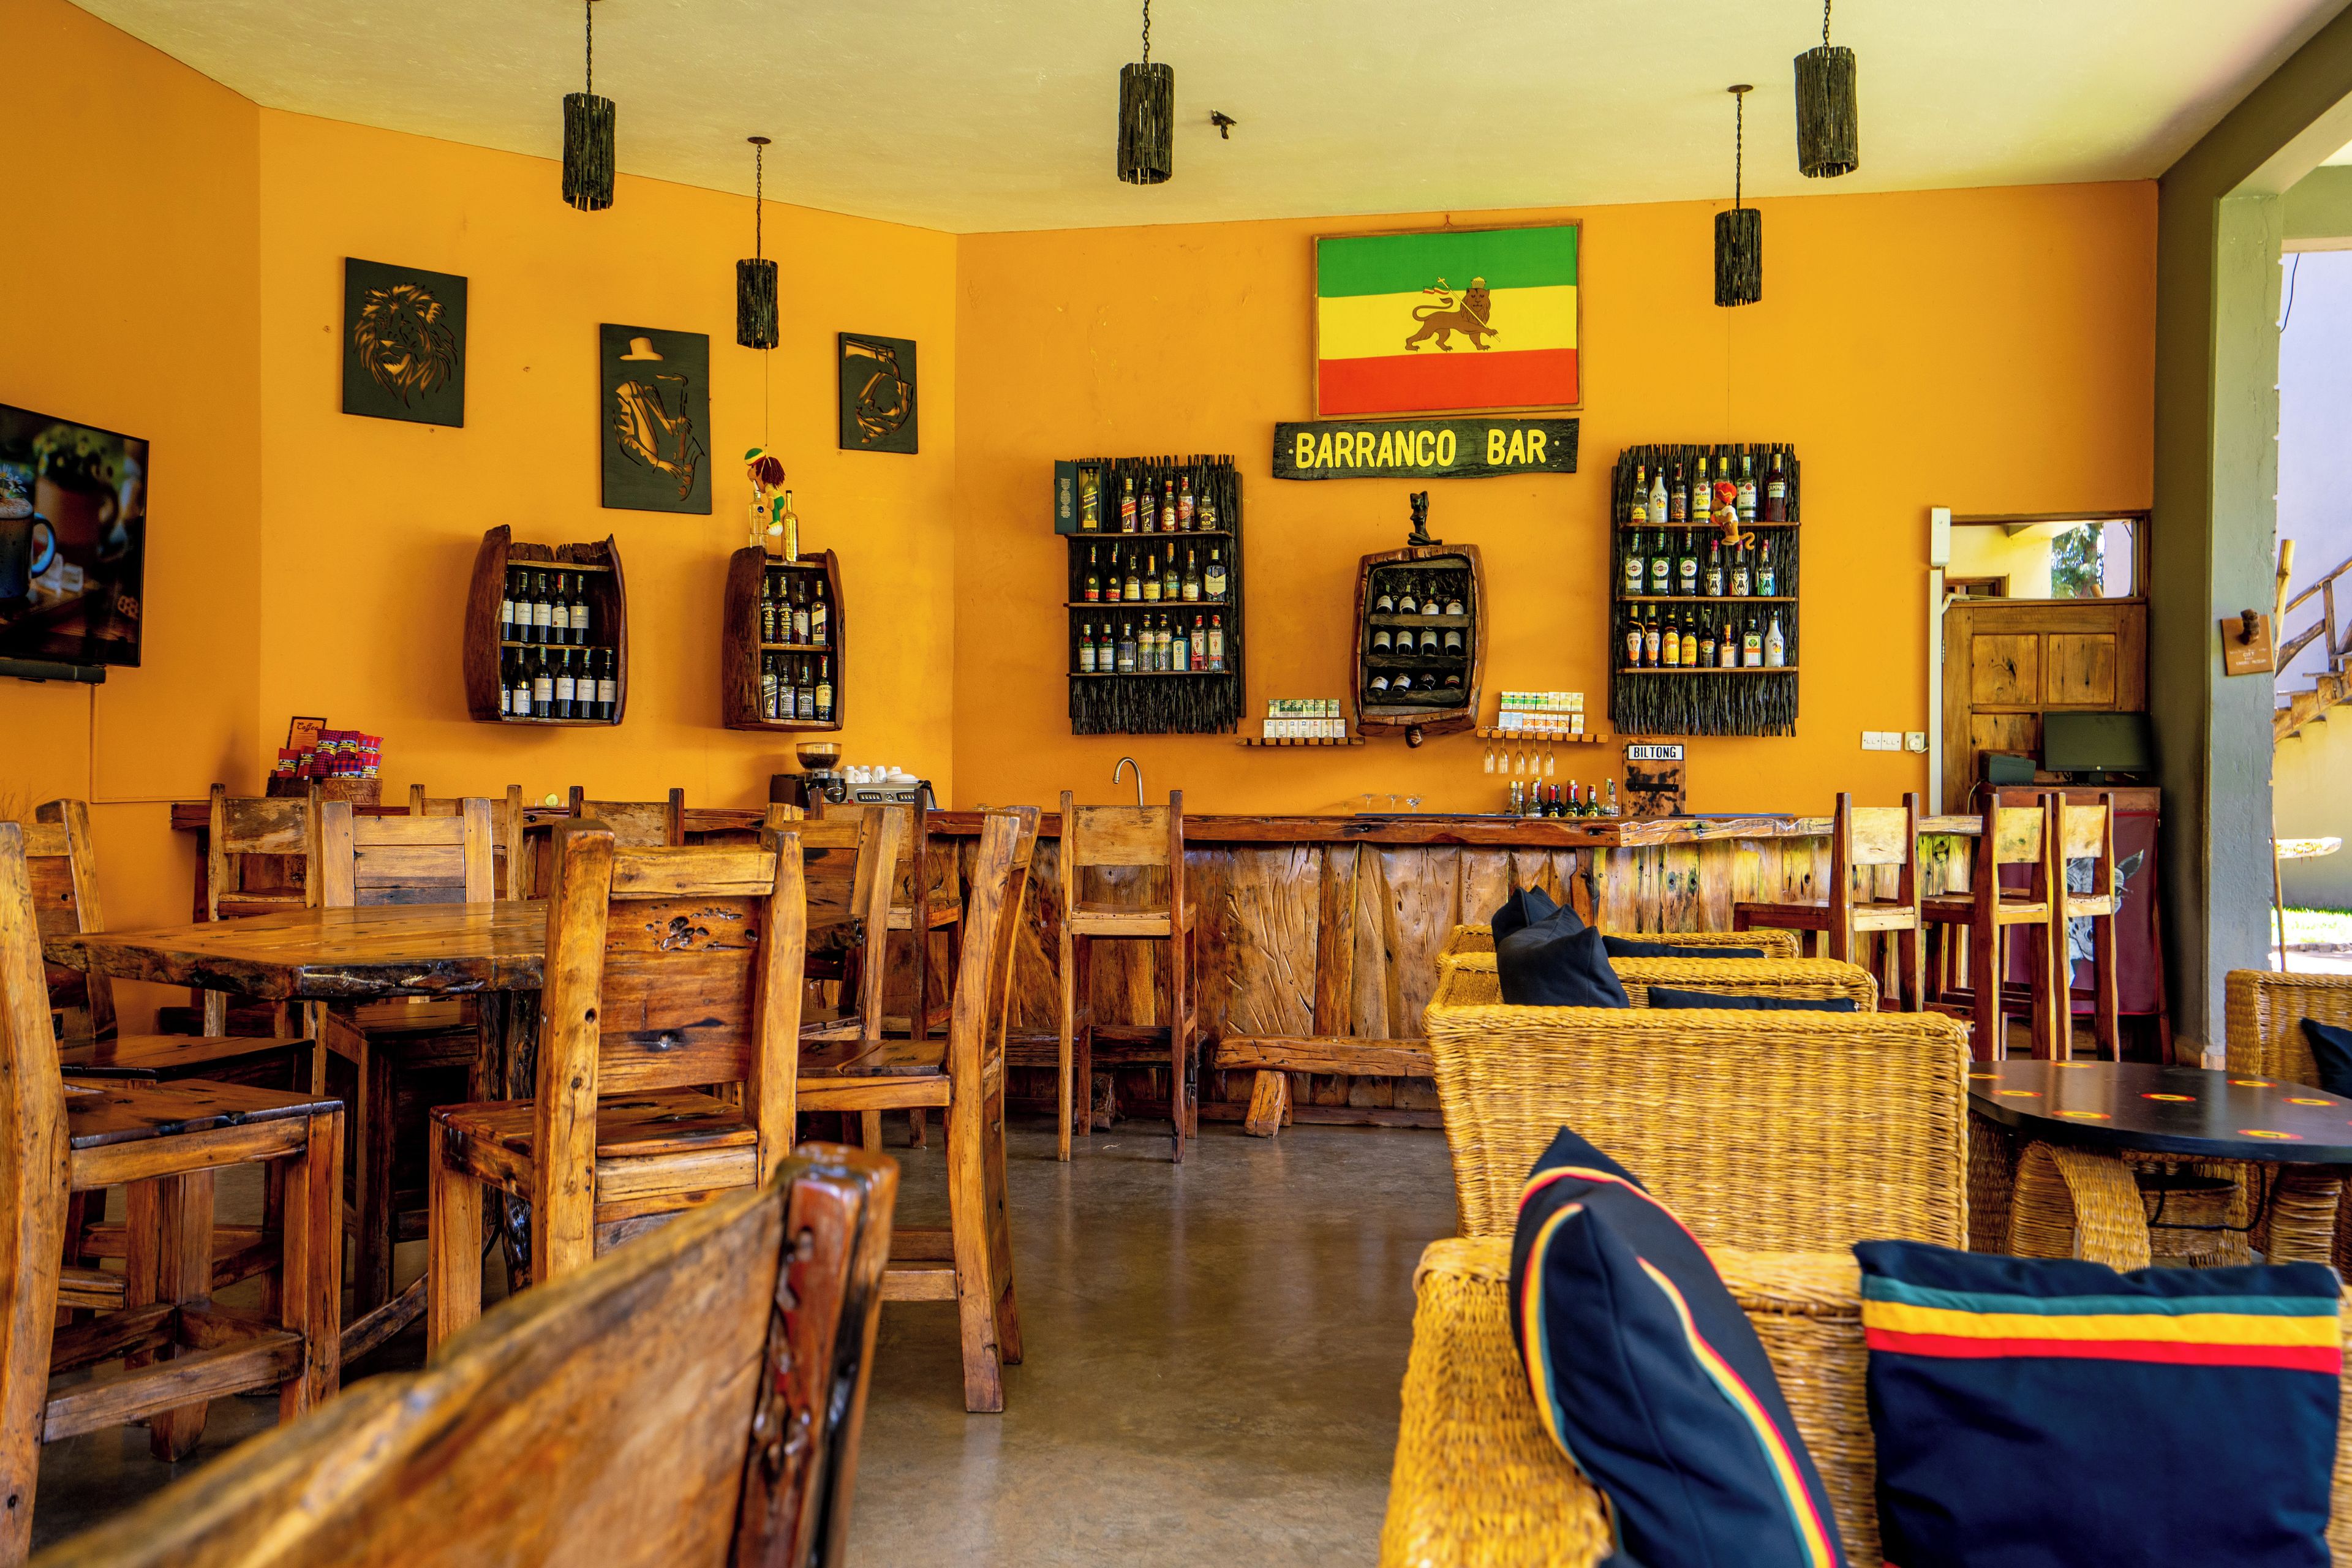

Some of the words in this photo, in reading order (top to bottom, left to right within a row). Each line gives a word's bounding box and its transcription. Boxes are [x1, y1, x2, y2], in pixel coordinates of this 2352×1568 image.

[1295, 429, 1457, 469] BARRANCO
[1487, 429, 1547, 466] BAR
[297, 722, 318, 732] Coffee
[1634, 747, 1676, 758] BILTONG
